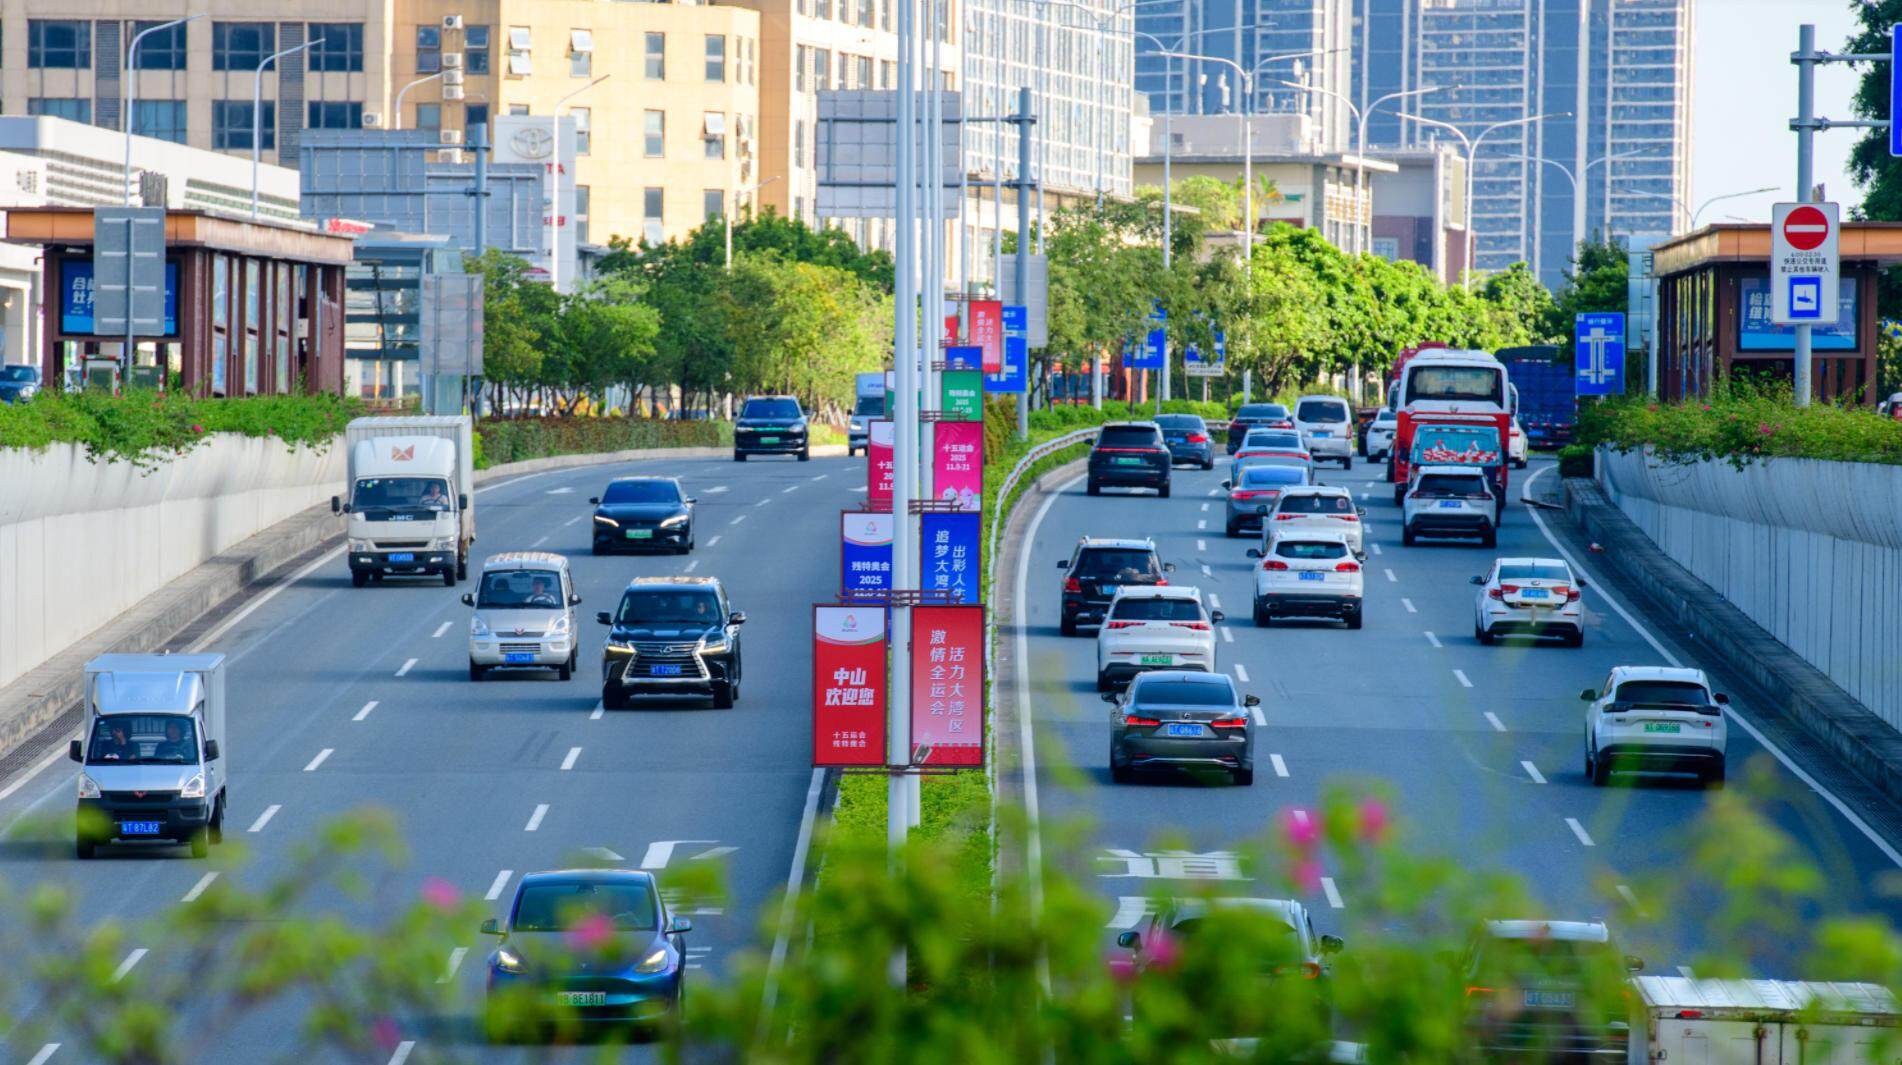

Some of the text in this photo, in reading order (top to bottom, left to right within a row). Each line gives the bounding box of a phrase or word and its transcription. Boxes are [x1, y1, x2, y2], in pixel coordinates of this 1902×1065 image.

[943, 444, 974, 453] 十五运会
[950, 454, 966, 462] 2025
[851, 561, 890, 572] 残特奥会
[859, 575, 882, 585] 2025
[834, 667, 866, 686] 中山
[930, 629, 947, 716] 激情全运会
[948, 647, 966, 733] 活力大湾区
[825, 688, 874, 706] 欢迎您
[833, 731, 866, 739] 十五运会
